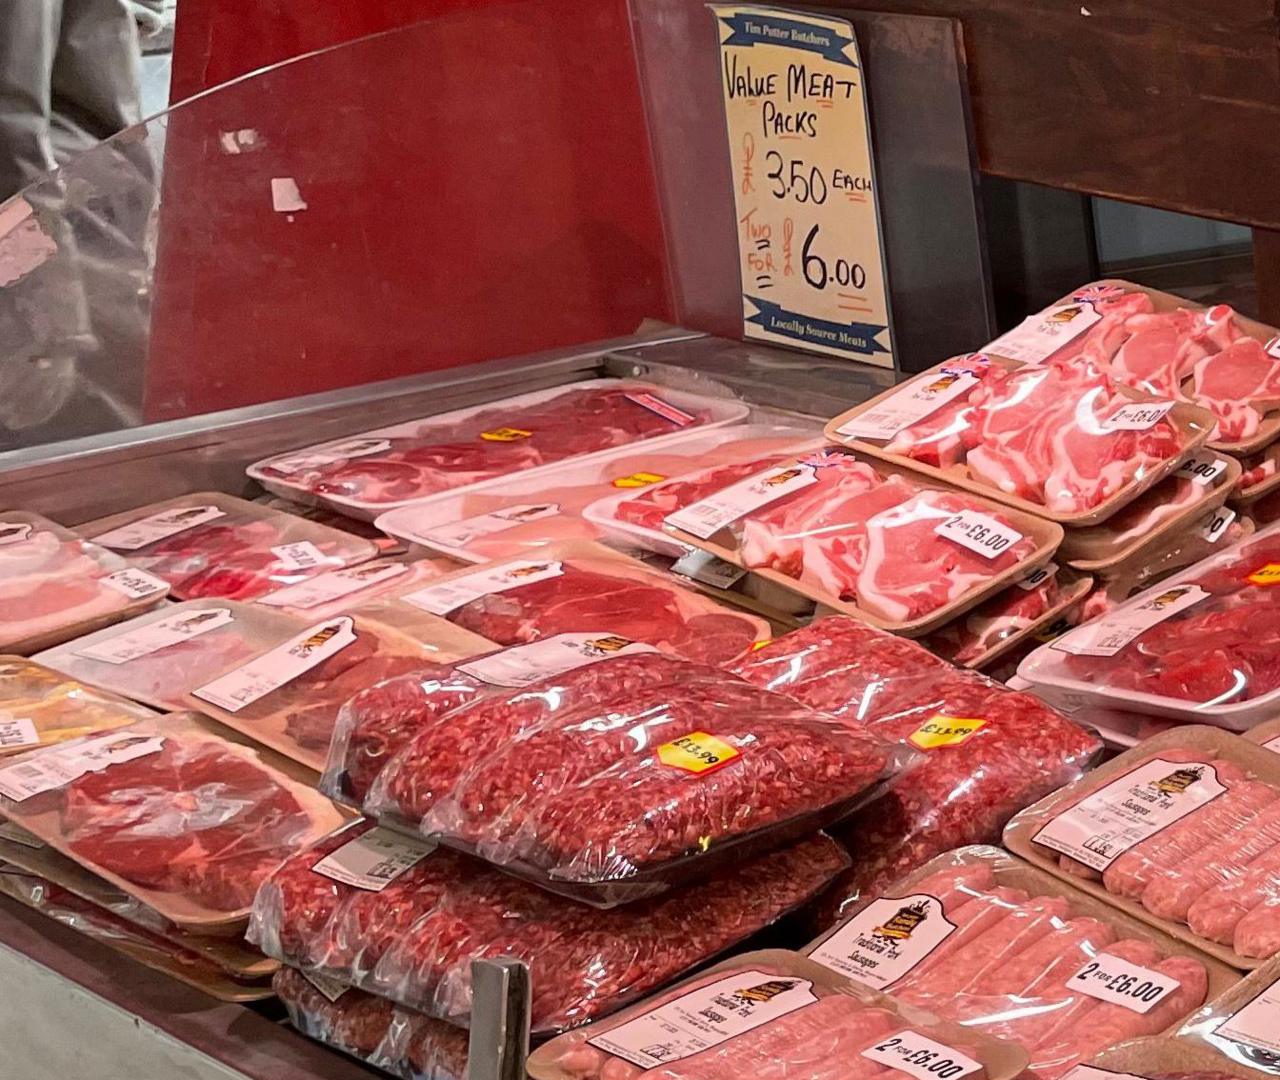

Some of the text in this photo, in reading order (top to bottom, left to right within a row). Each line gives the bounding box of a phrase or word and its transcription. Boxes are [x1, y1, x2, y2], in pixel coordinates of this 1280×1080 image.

[744, 22, 761, 34] Tim
[791, 29, 830, 46] Butchers
[724, 51, 857, 102] VALUE MEAT
[763, 101, 817, 138] PACKS
[833, 169, 872, 191] EACH
[740, 207, 771, 240] TWO
[748, 253, 777, 272] FOR
[771, 316, 867, 348] Locally Source Meats
[945, 515, 961, 528] 2
[965, 522, 1010, 551] £6.00
[1076, 962, 1164, 1002] 2 FOR £6.00
[875, 1039, 963, 1079] 2 FOR £6.00
